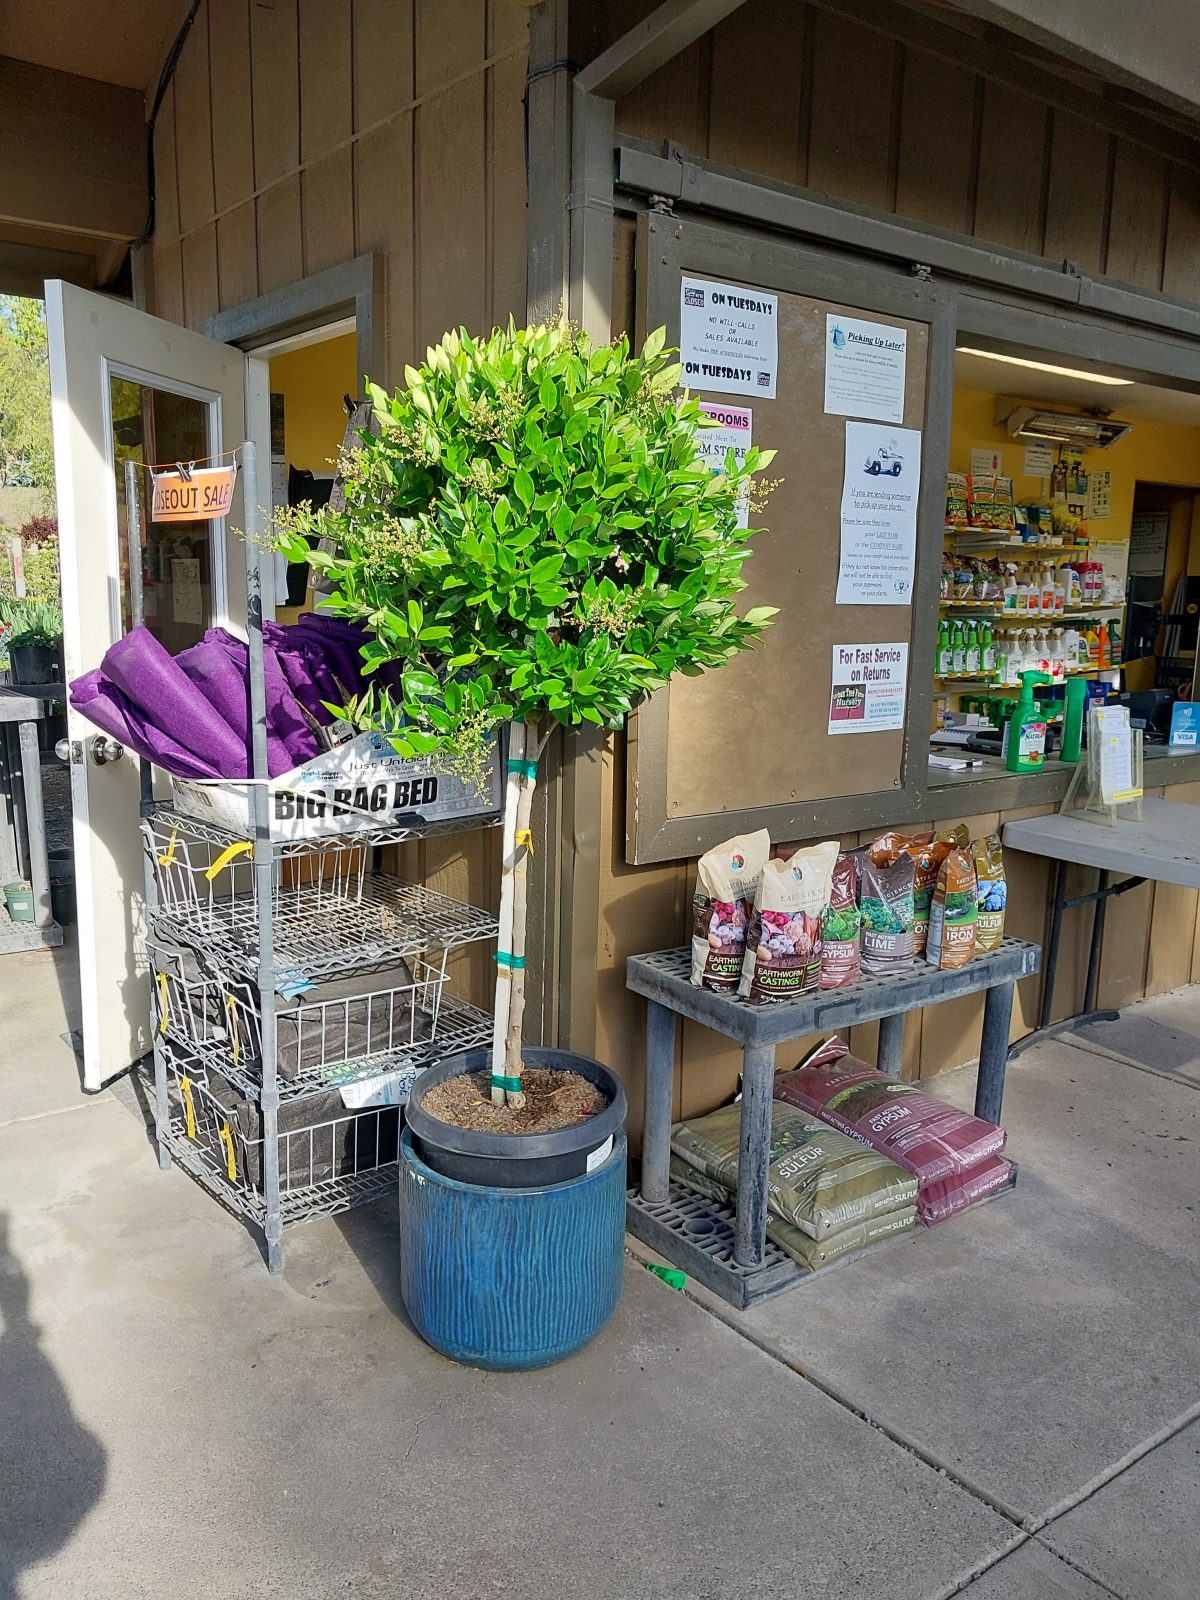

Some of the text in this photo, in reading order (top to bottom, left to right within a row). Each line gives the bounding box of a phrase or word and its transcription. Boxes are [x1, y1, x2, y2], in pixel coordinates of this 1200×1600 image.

[685, 296, 704, 307] CLOSED
[712, 292, 772, 315] ON TUESDAYS
[720, 318, 755, 330] WILL-CALLS
[705, 332, 759, 347] SALES AVAILABLE
[848, 332, 905, 350] Picking Up Later?
[685, 361, 699, 374] ON
[701, 364, 752, 381] TUESDAYS
[715, 434, 728, 442] Next
[155, 483, 230, 511] OSEOUT SALE
[874, 491, 891, 501] sending
[854, 500, 860, 508] to
[861, 501, 871, 509] pick
[846, 562, 855, 570] they
[840, 647, 901, 664] For Fast Service
[850, 665, 891, 681] on Returns
[836, 698, 862, 709] Nursery
[349, 762, 378, 773] Just
[275, 776, 438, 820] BIG BAG BED
[946, 929, 974, 941] IRON
[864, 937, 896, 950] LIME
[822, 947, 855, 959] GYPSUM
[757, 967, 803, 978] EARTHWORM
[760, 976, 800, 986] CASTINGS
[868, 1104, 901, 1124] FAST ACTING
[871, 1107, 913, 1132] GYPSUM
[821, 1111, 874, 1149] FAST ACTING GYPSUM
[983, 1139, 1004, 1156] GYPSUM
[777, 1145, 814, 1169] FAST ACTING
[779, 1147, 826, 1179] SULFUR
[989, 1173, 1009, 1188] GYPSUM
[869, 1215, 915, 1236] FAST ACTING SULFUR
